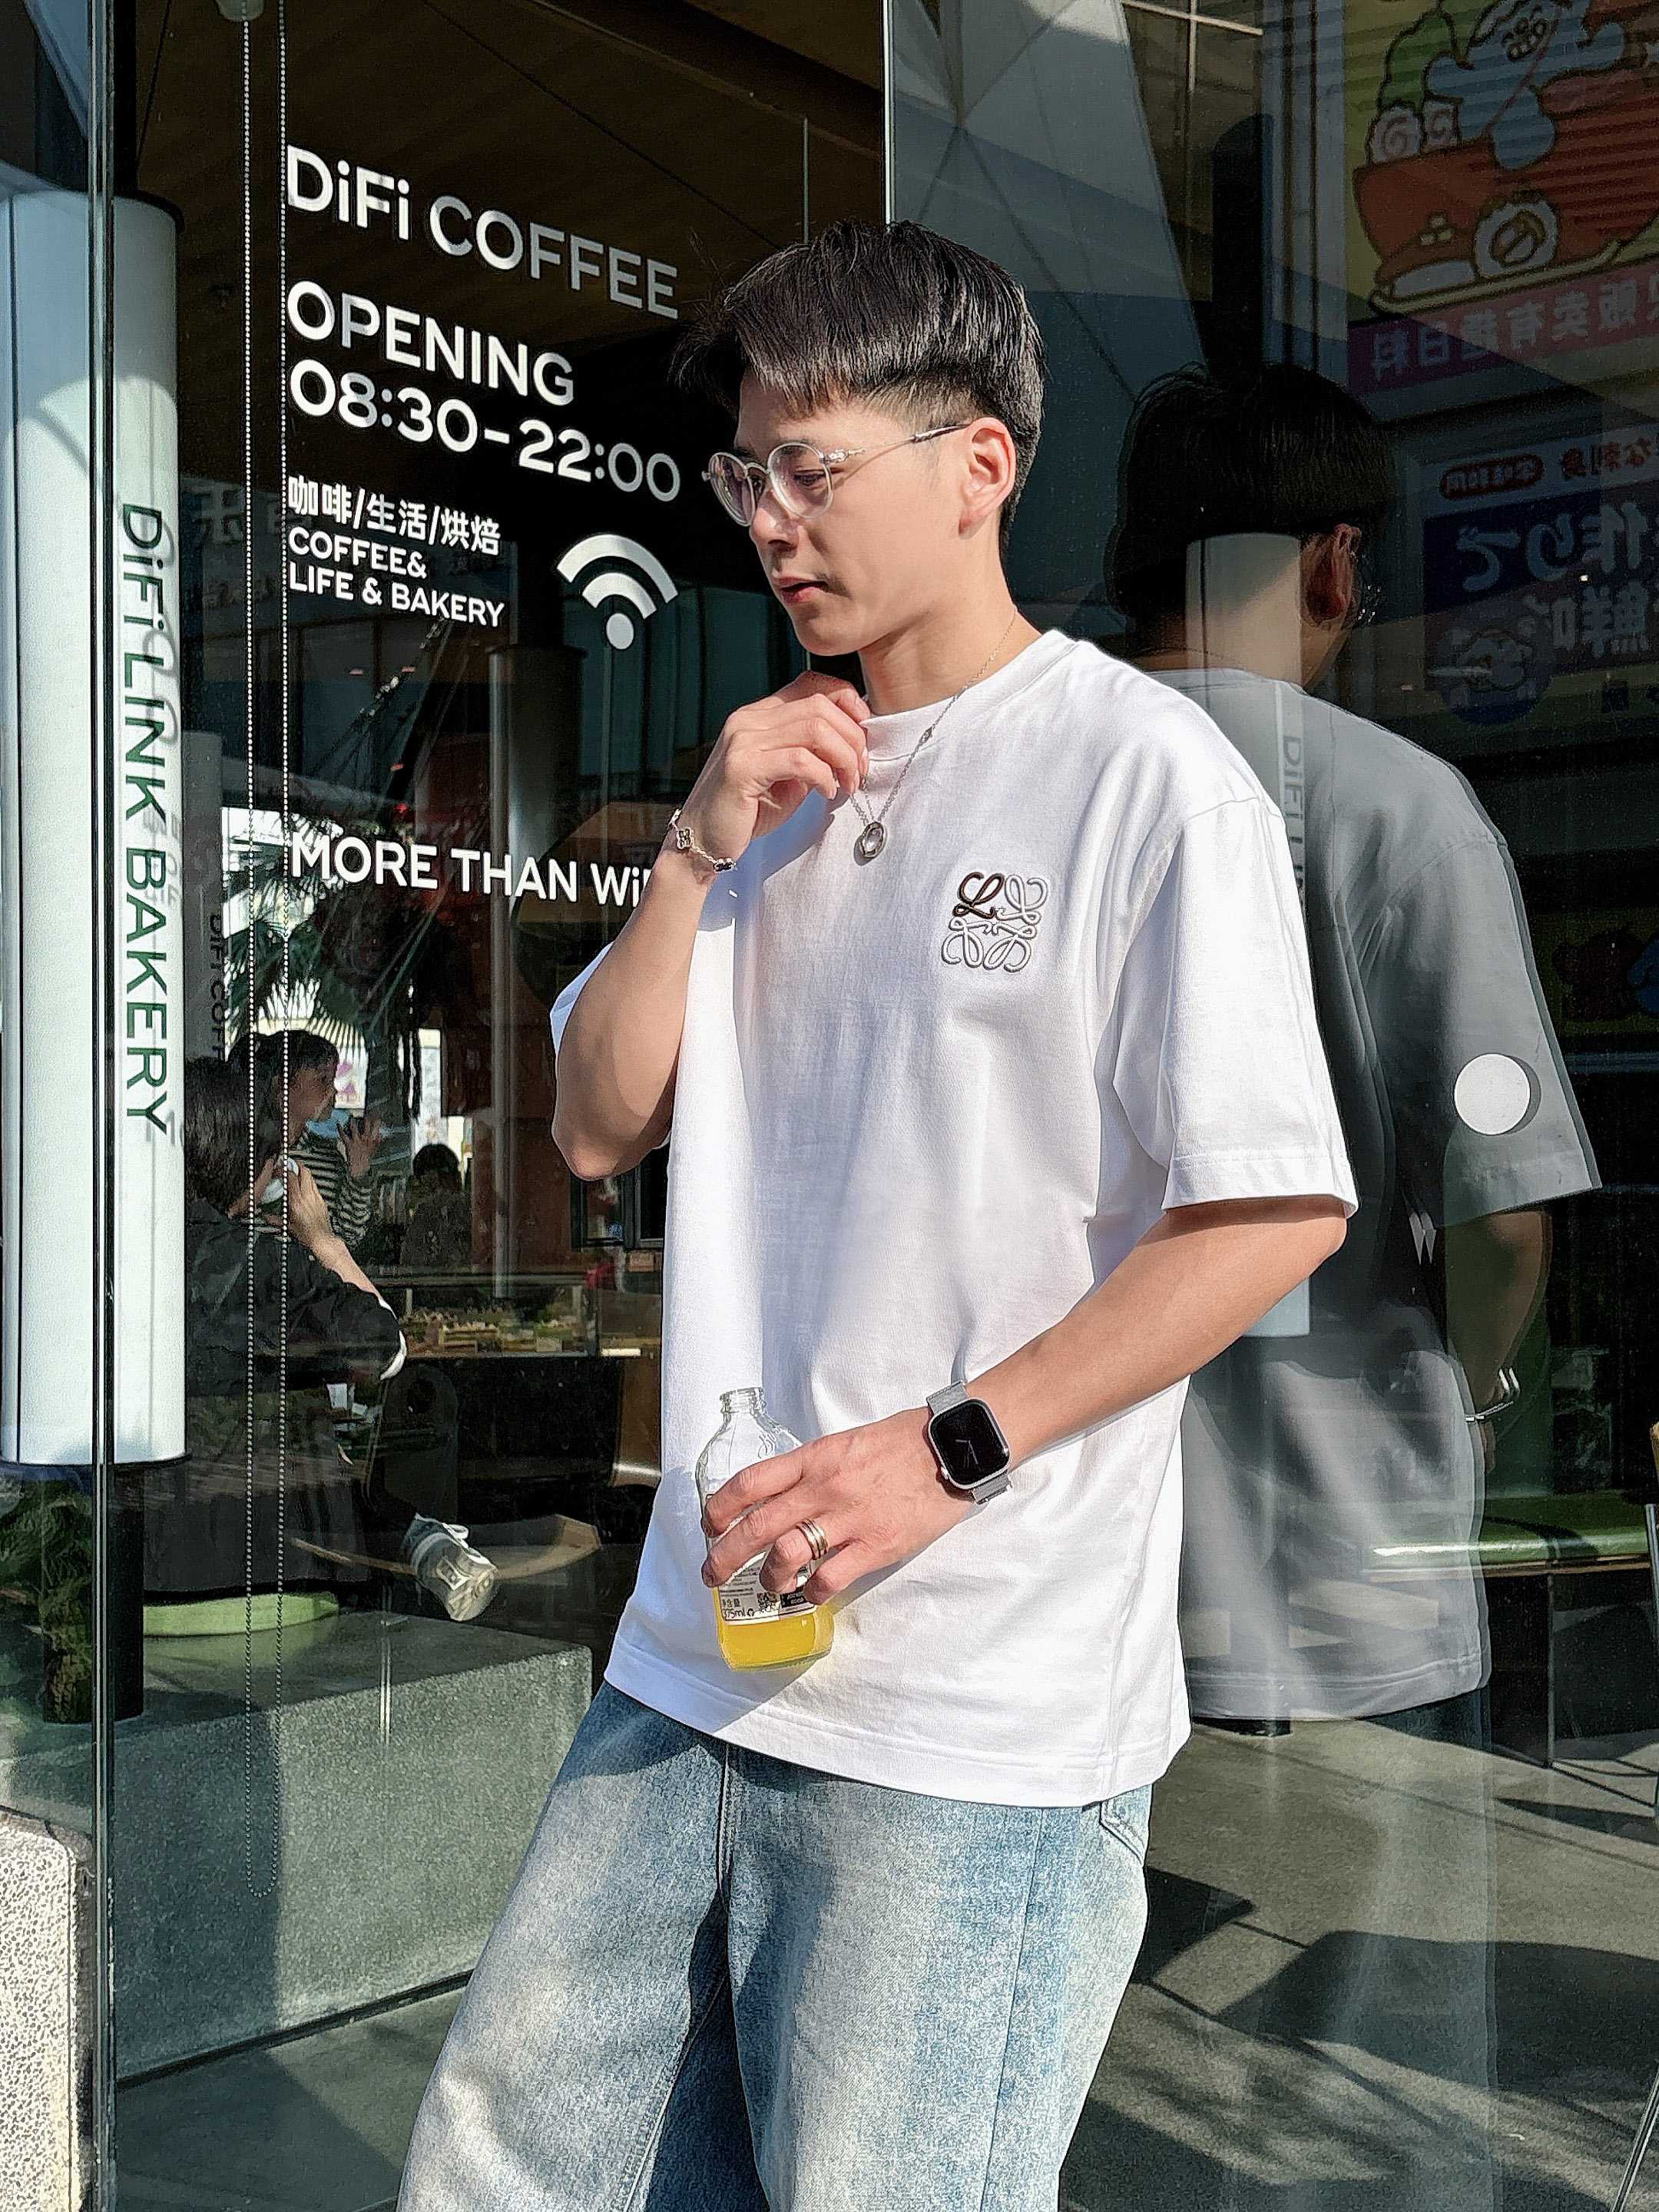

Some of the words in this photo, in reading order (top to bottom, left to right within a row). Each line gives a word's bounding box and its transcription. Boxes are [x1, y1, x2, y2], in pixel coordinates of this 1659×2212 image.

[287, 144, 411, 241] DiFi
[429, 194, 679, 320] COFFEE
[286, 280, 575, 406] OPENING
[290, 359, 680, 502] 08:30-22:00
[123, 503, 164, 631] DiFi
[288, 475, 502, 555] 咖啡/生活/烘焙
[288, 526, 428, 578] COFFEE&
[289, 561, 354, 601] LIFE
[362, 574, 382, 606] &
[391, 581, 505, 628] BAKERY
[123, 652, 166, 823] LINK
[292, 832, 438, 889] MORE
[451, 848, 577, 902] THAN
[125, 846, 168, 1136] BAKERY
